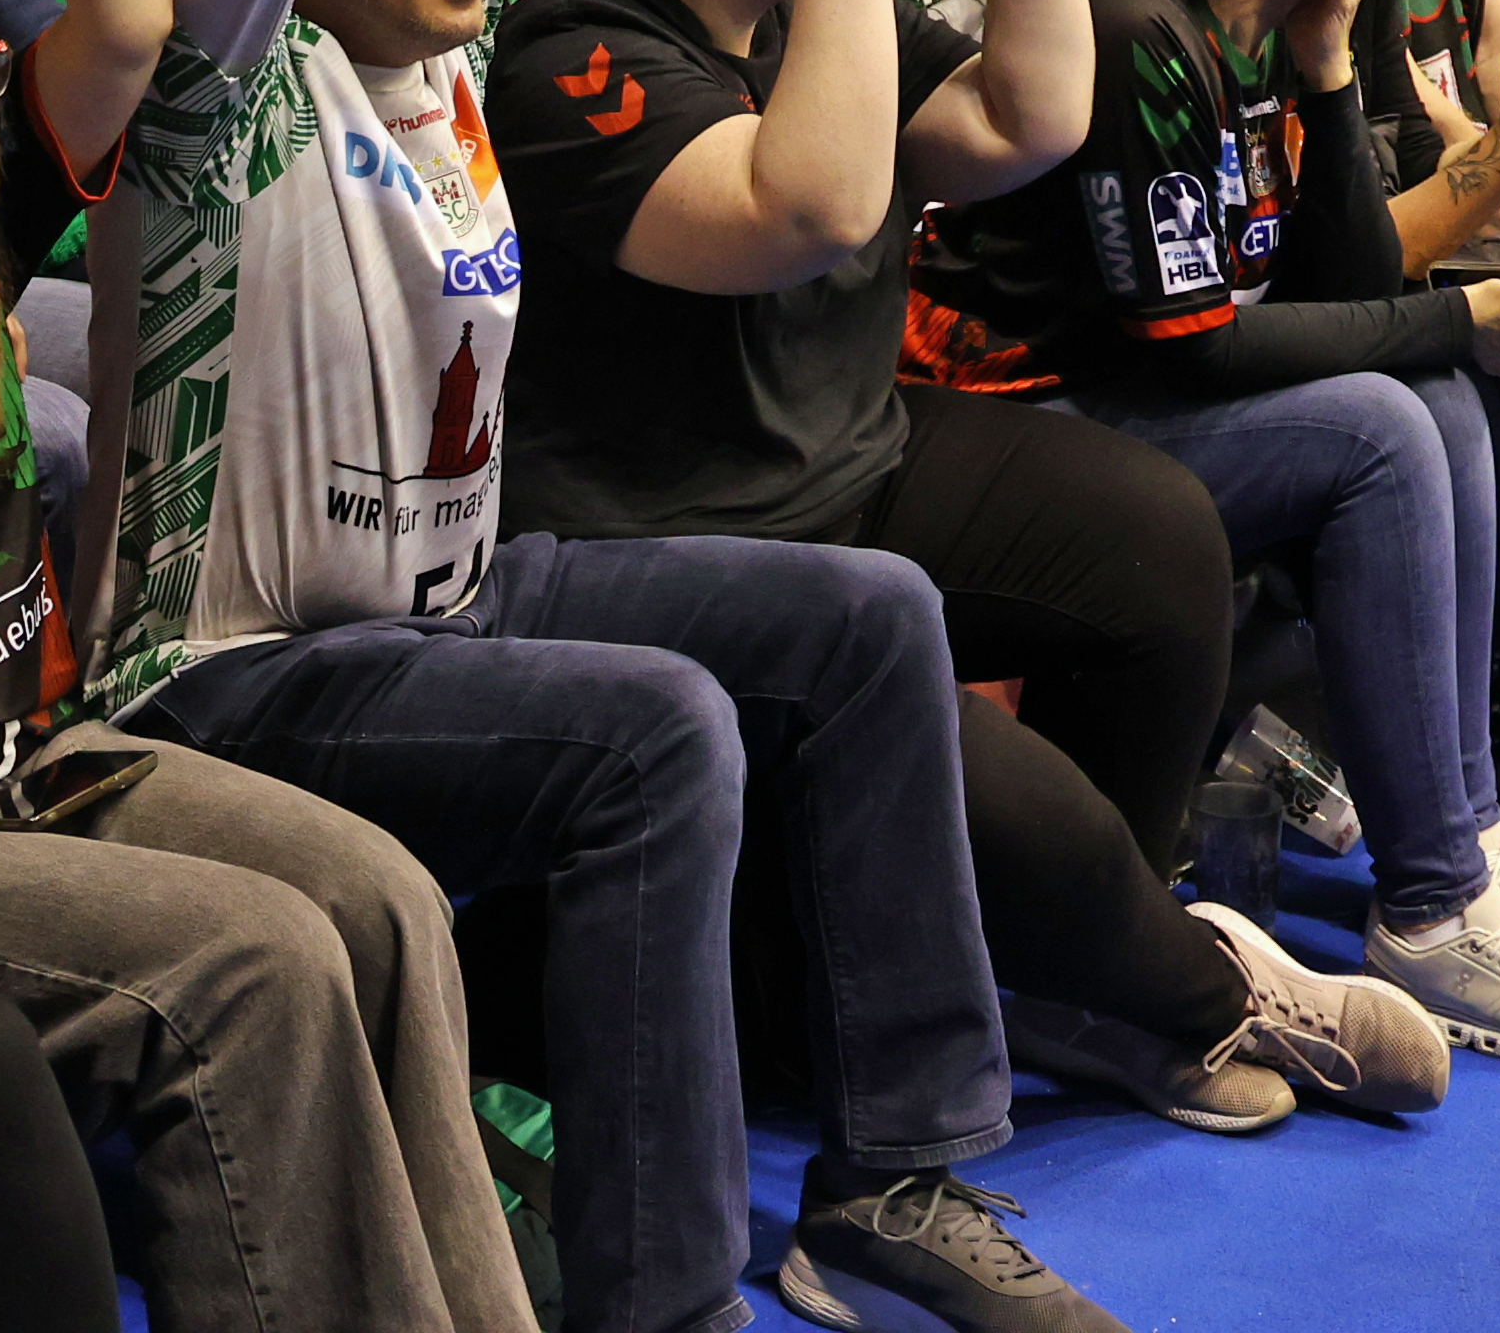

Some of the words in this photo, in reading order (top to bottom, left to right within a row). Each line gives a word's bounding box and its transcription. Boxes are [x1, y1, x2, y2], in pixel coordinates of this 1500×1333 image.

[1091, 175, 1136, 294] SWM
[1166, 260, 1219, 285] HBL
[326, 485, 383, 532] WIR
[393, 505, 421, 537] für
